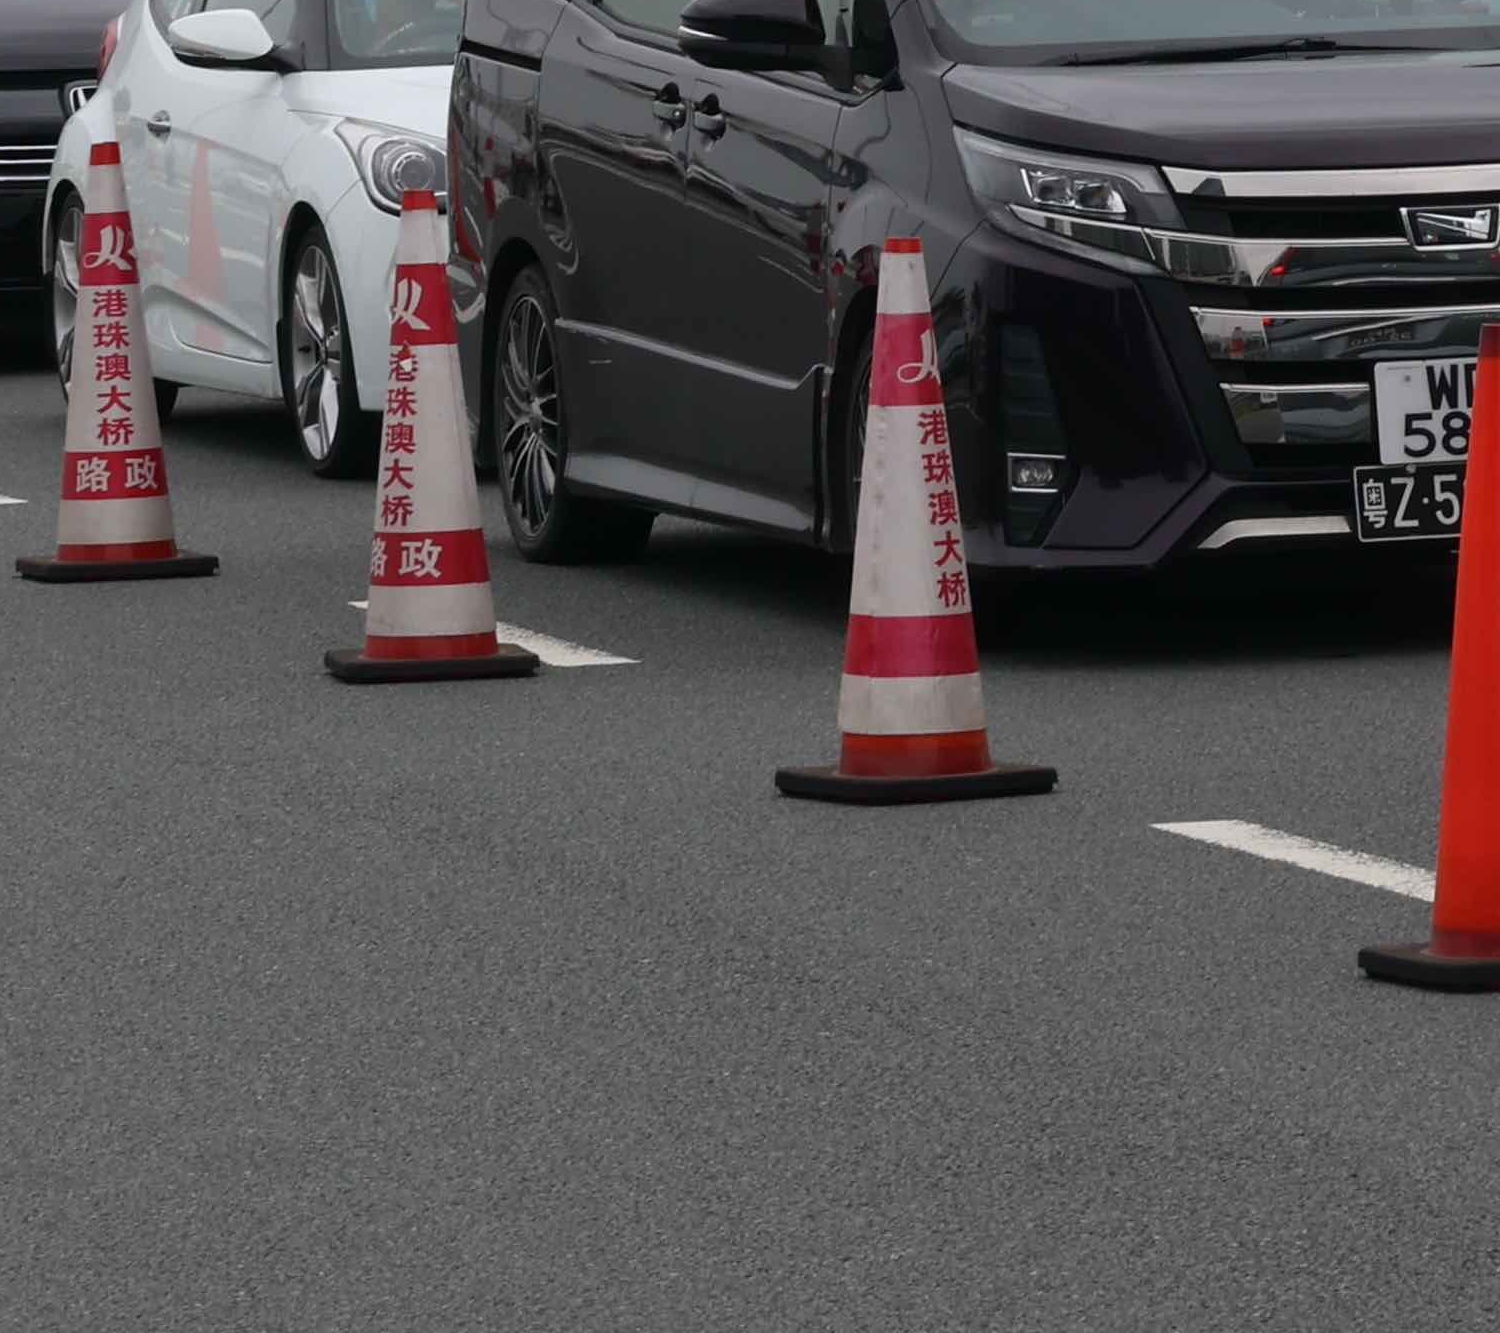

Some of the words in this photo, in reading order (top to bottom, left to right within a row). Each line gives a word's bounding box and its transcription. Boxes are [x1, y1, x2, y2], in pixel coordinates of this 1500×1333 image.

[92, 289, 134, 446] 港珠澳大桥
[380, 349, 419, 527] 港珠澳大桥
[75, 456, 159, 494] 路政
[917, 409, 967, 608] 港珠澳大桥
